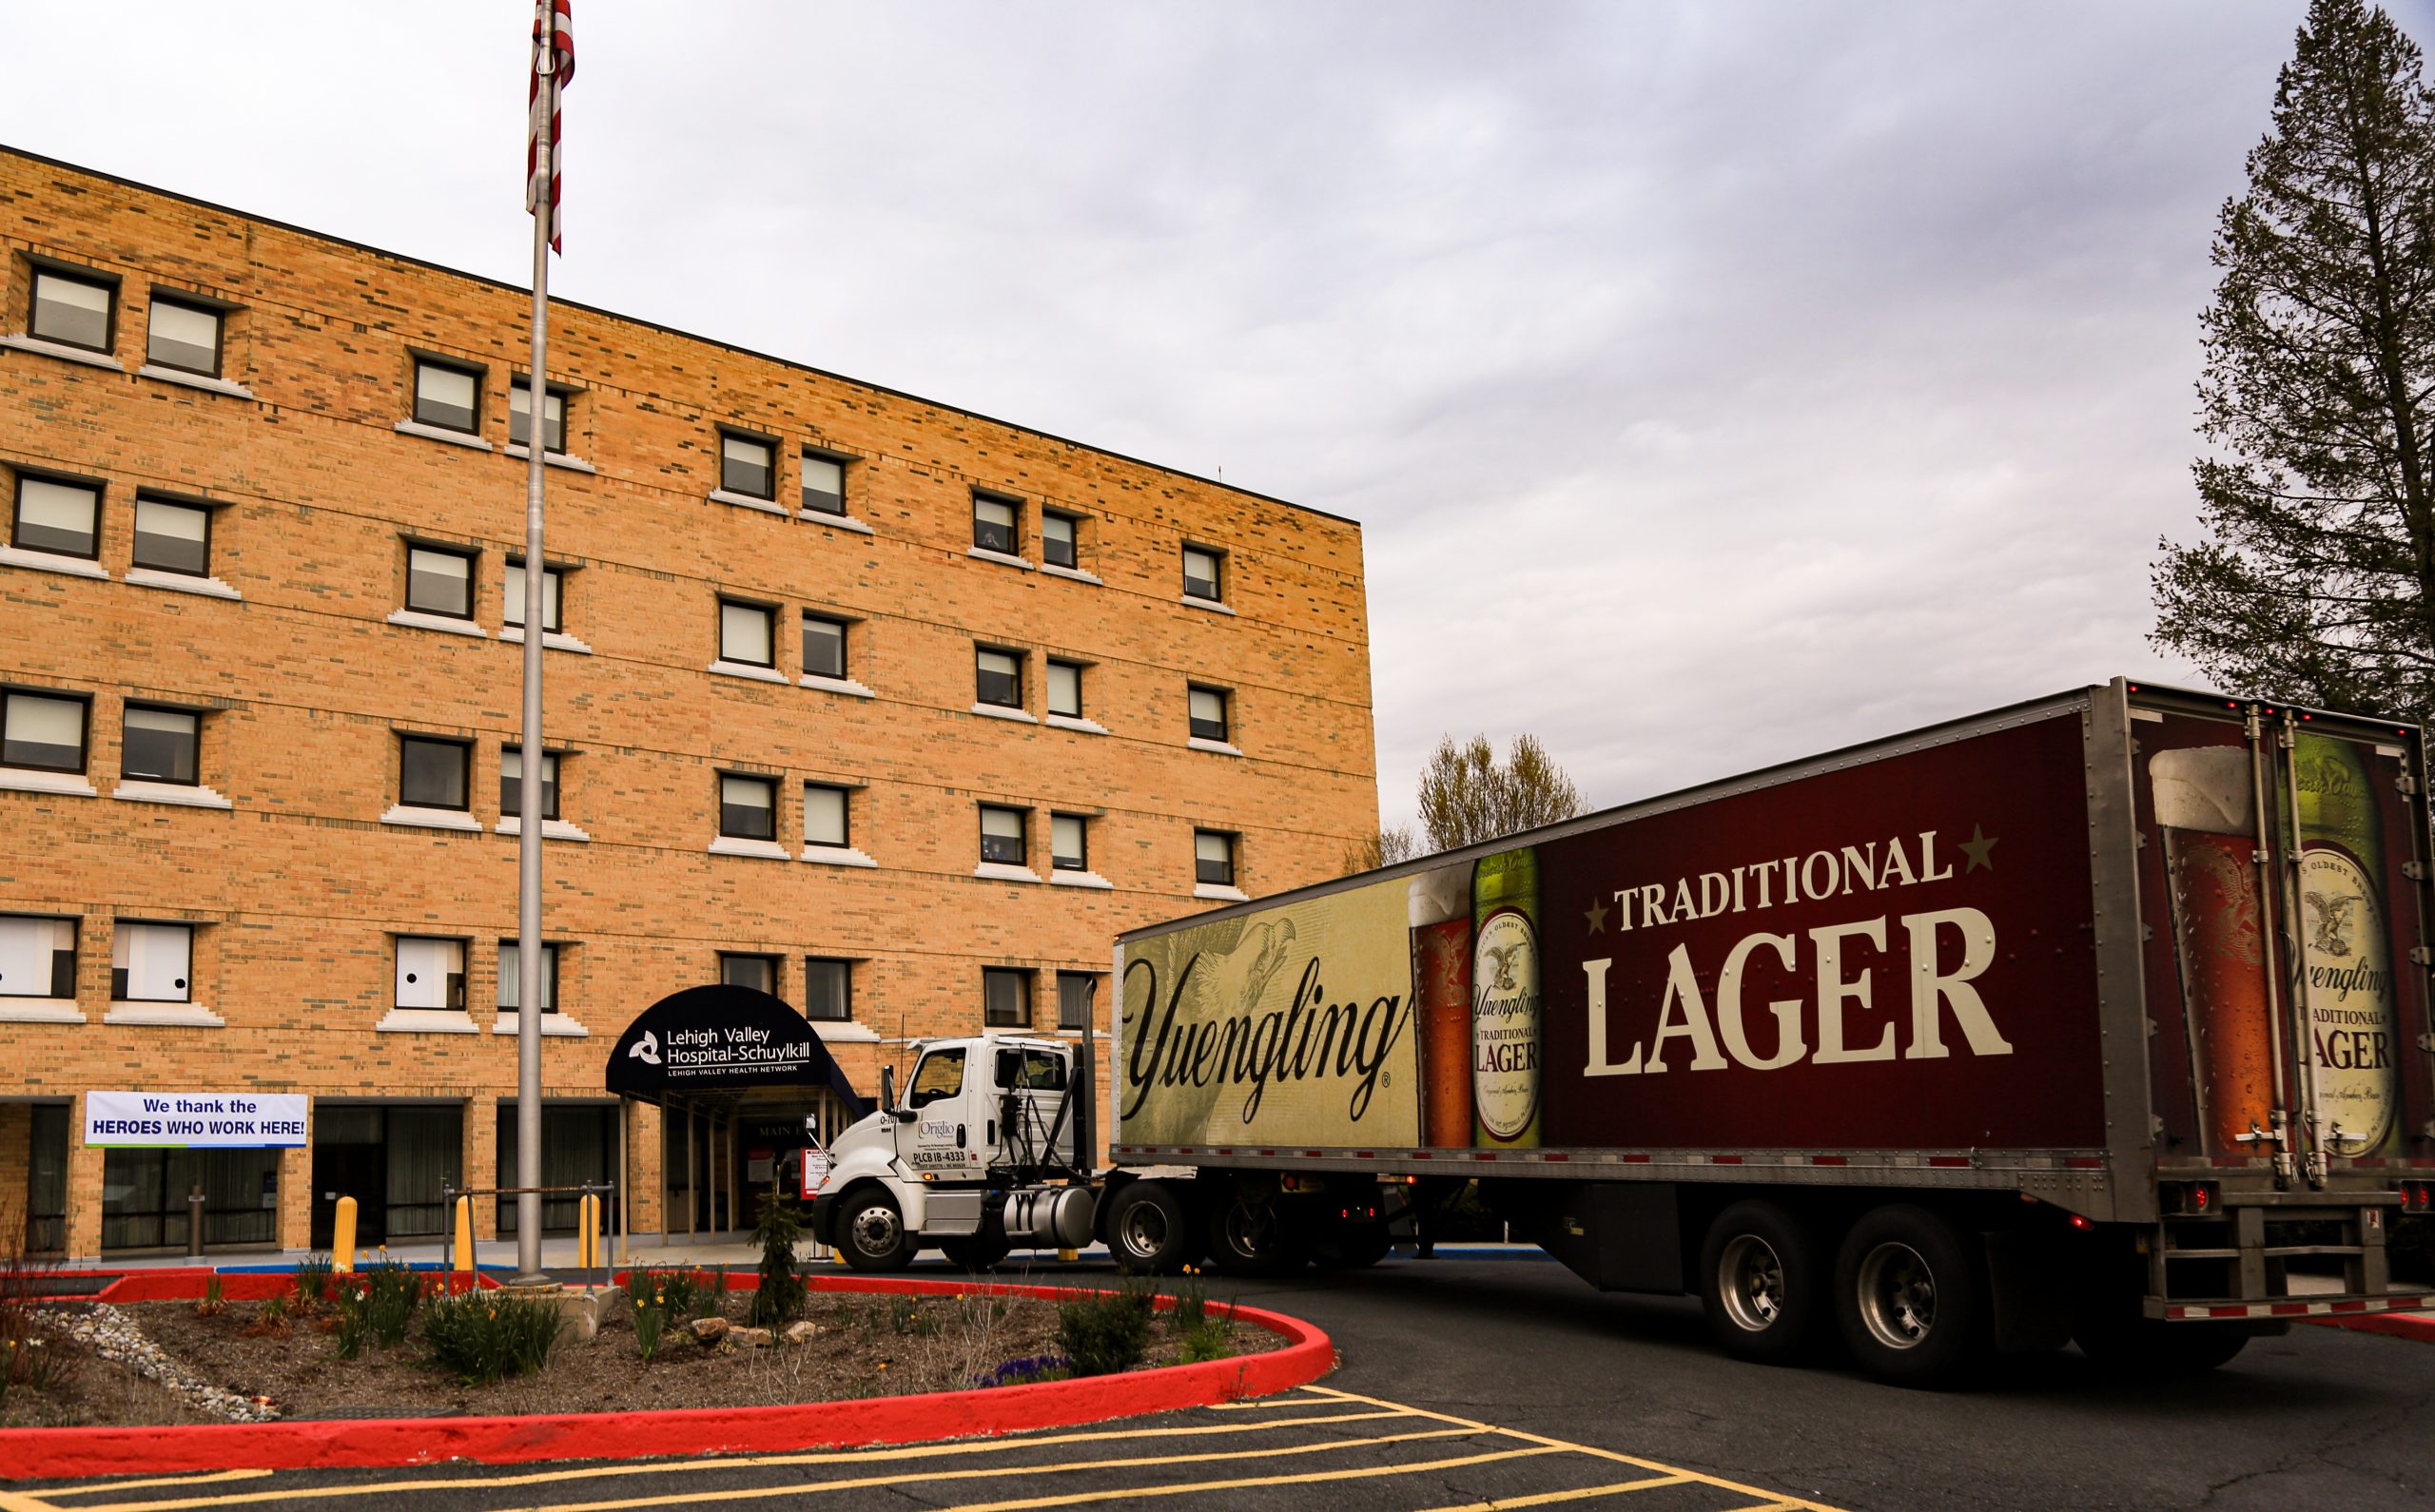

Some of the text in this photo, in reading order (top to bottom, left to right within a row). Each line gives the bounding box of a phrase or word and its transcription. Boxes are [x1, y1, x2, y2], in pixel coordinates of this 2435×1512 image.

[2310, 861, 2348, 876] OLDEST
[1614, 830, 1953, 931] TRADITIONAL
[1494, 921, 1518, 931] OLDEST
[1583, 906, 2014, 1076] LAGER
[1472, 984, 1538, 1023] Yuengling
[2298, 1005, 2382, 1025] TADITIONAL
[668, 1026, 769, 1047] Lehigh Valley
[1120, 952, 1415, 1125] Yuengling
[1480, 1026, 1532, 1040] TRADITIONAL
[668, 1042, 809, 1065] Hospital-Schuylkill
[1475, 1042, 1538, 1073] LAGER
[2299, 1027, 2391, 1070] AGER
[143, 1098, 257, 1113] We thank the
[93, 1120, 304, 1134] HEROES WHO WORK HERE!
[759, 1126, 790, 1136] MAIN
[921, 1120, 955, 1138] Origlio
[913, 1153, 933, 1163] PLCB
